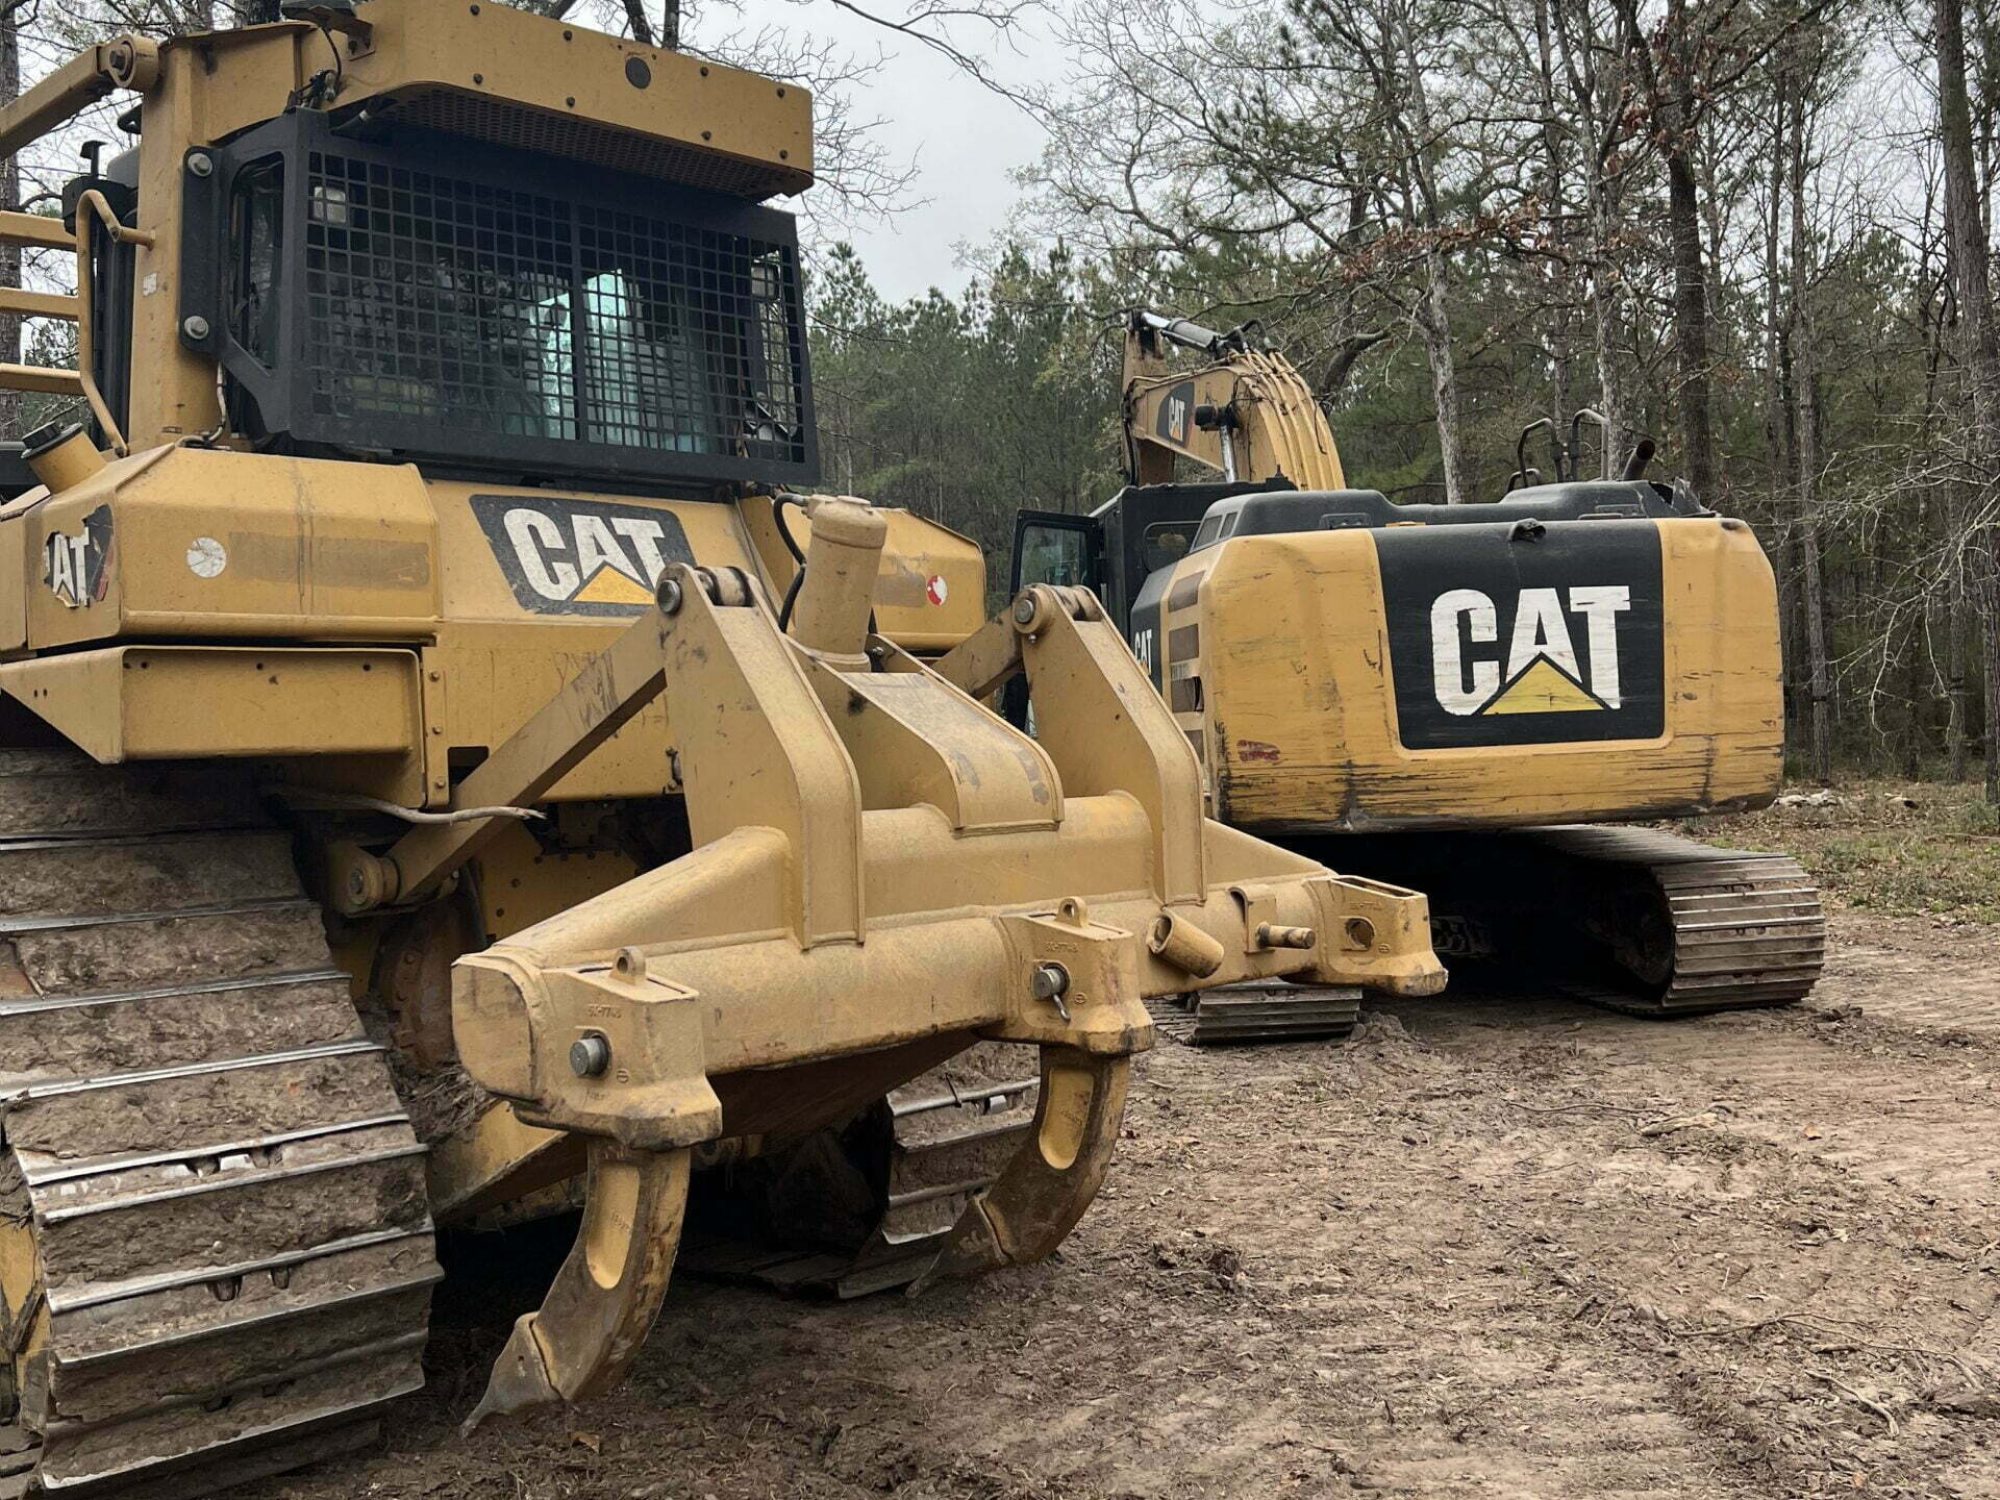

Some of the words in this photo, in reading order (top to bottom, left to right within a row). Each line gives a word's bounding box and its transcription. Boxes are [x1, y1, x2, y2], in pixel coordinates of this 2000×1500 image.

[1169, 396, 1185, 441] CAT
[44, 526, 89, 606] AT
[504, 508, 665, 600] CAT
[1135, 628, 1152, 676] CAT
[1430, 585, 1631, 716] CAT
